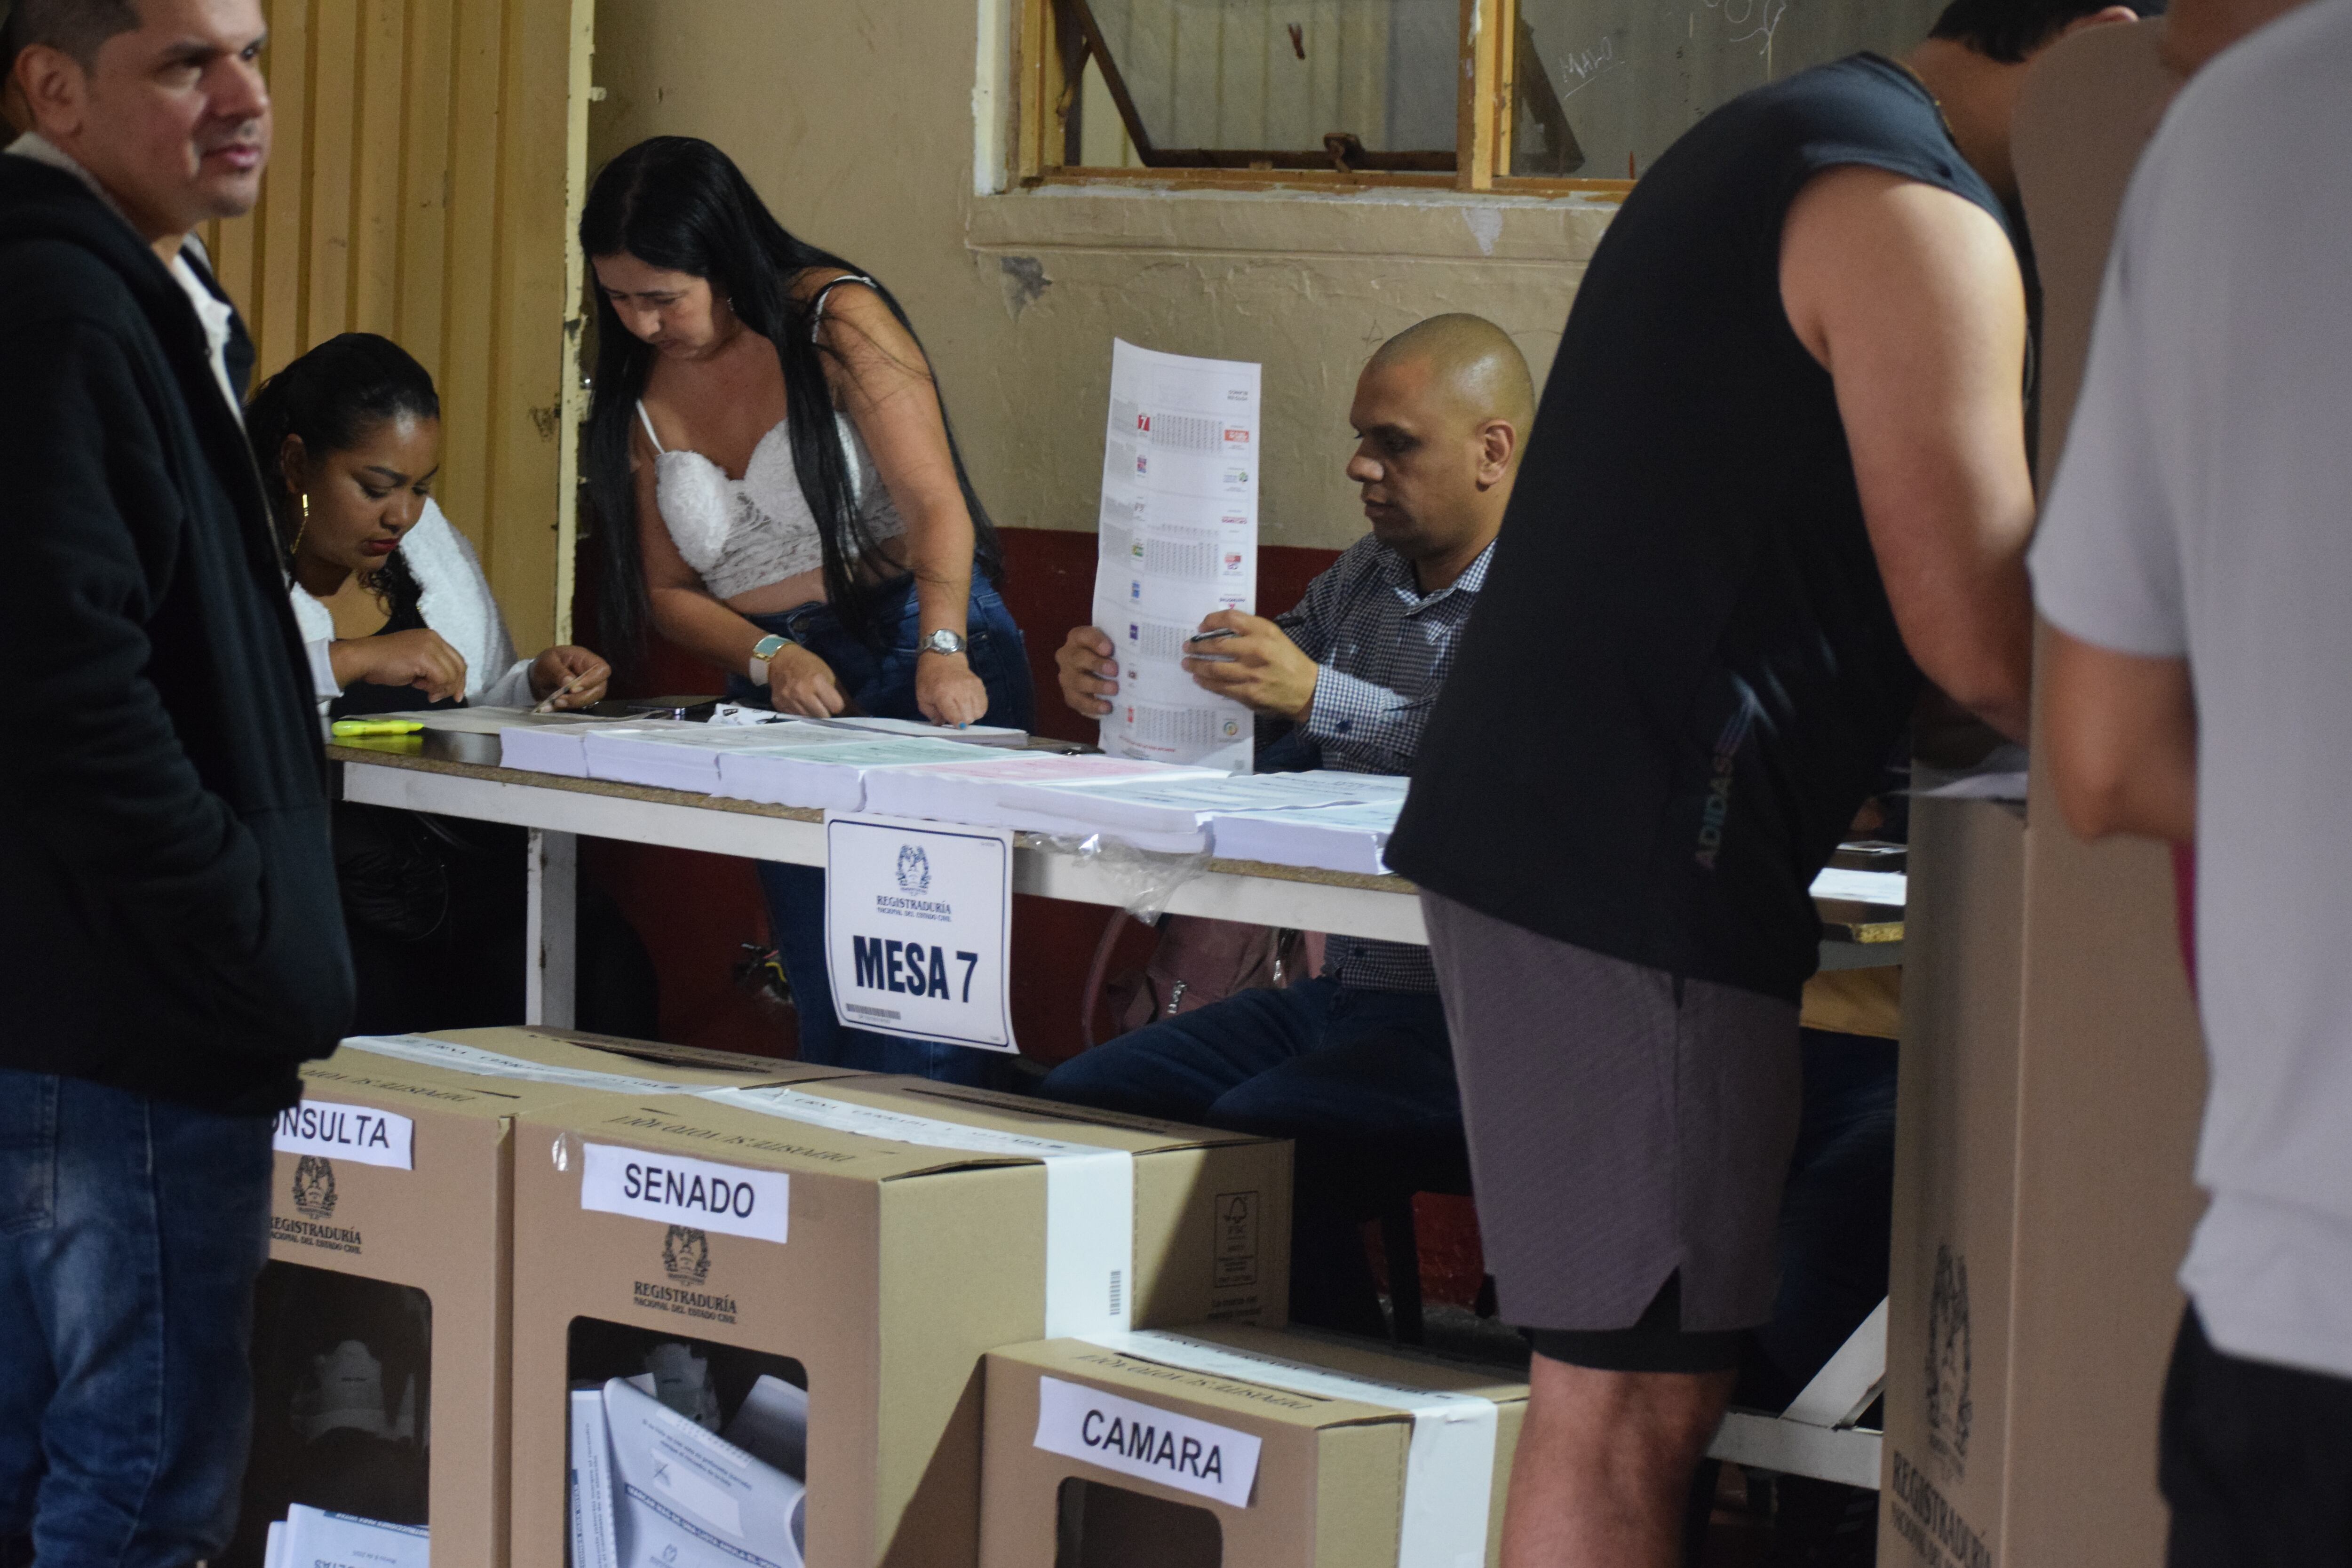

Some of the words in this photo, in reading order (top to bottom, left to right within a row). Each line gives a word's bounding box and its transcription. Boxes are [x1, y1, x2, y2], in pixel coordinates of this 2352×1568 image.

[877, 895, 952, 914] REGISTRADURÍA
[853, 935, 950, 1000] MESA
[956, 950, 978, 1003] 7
[624, 1163, 755, 1218] SENADO
[635, 1281, 737, 1313] REGISTRADURÍA
[1081, 1409, 1223, 1484] CAMARA
